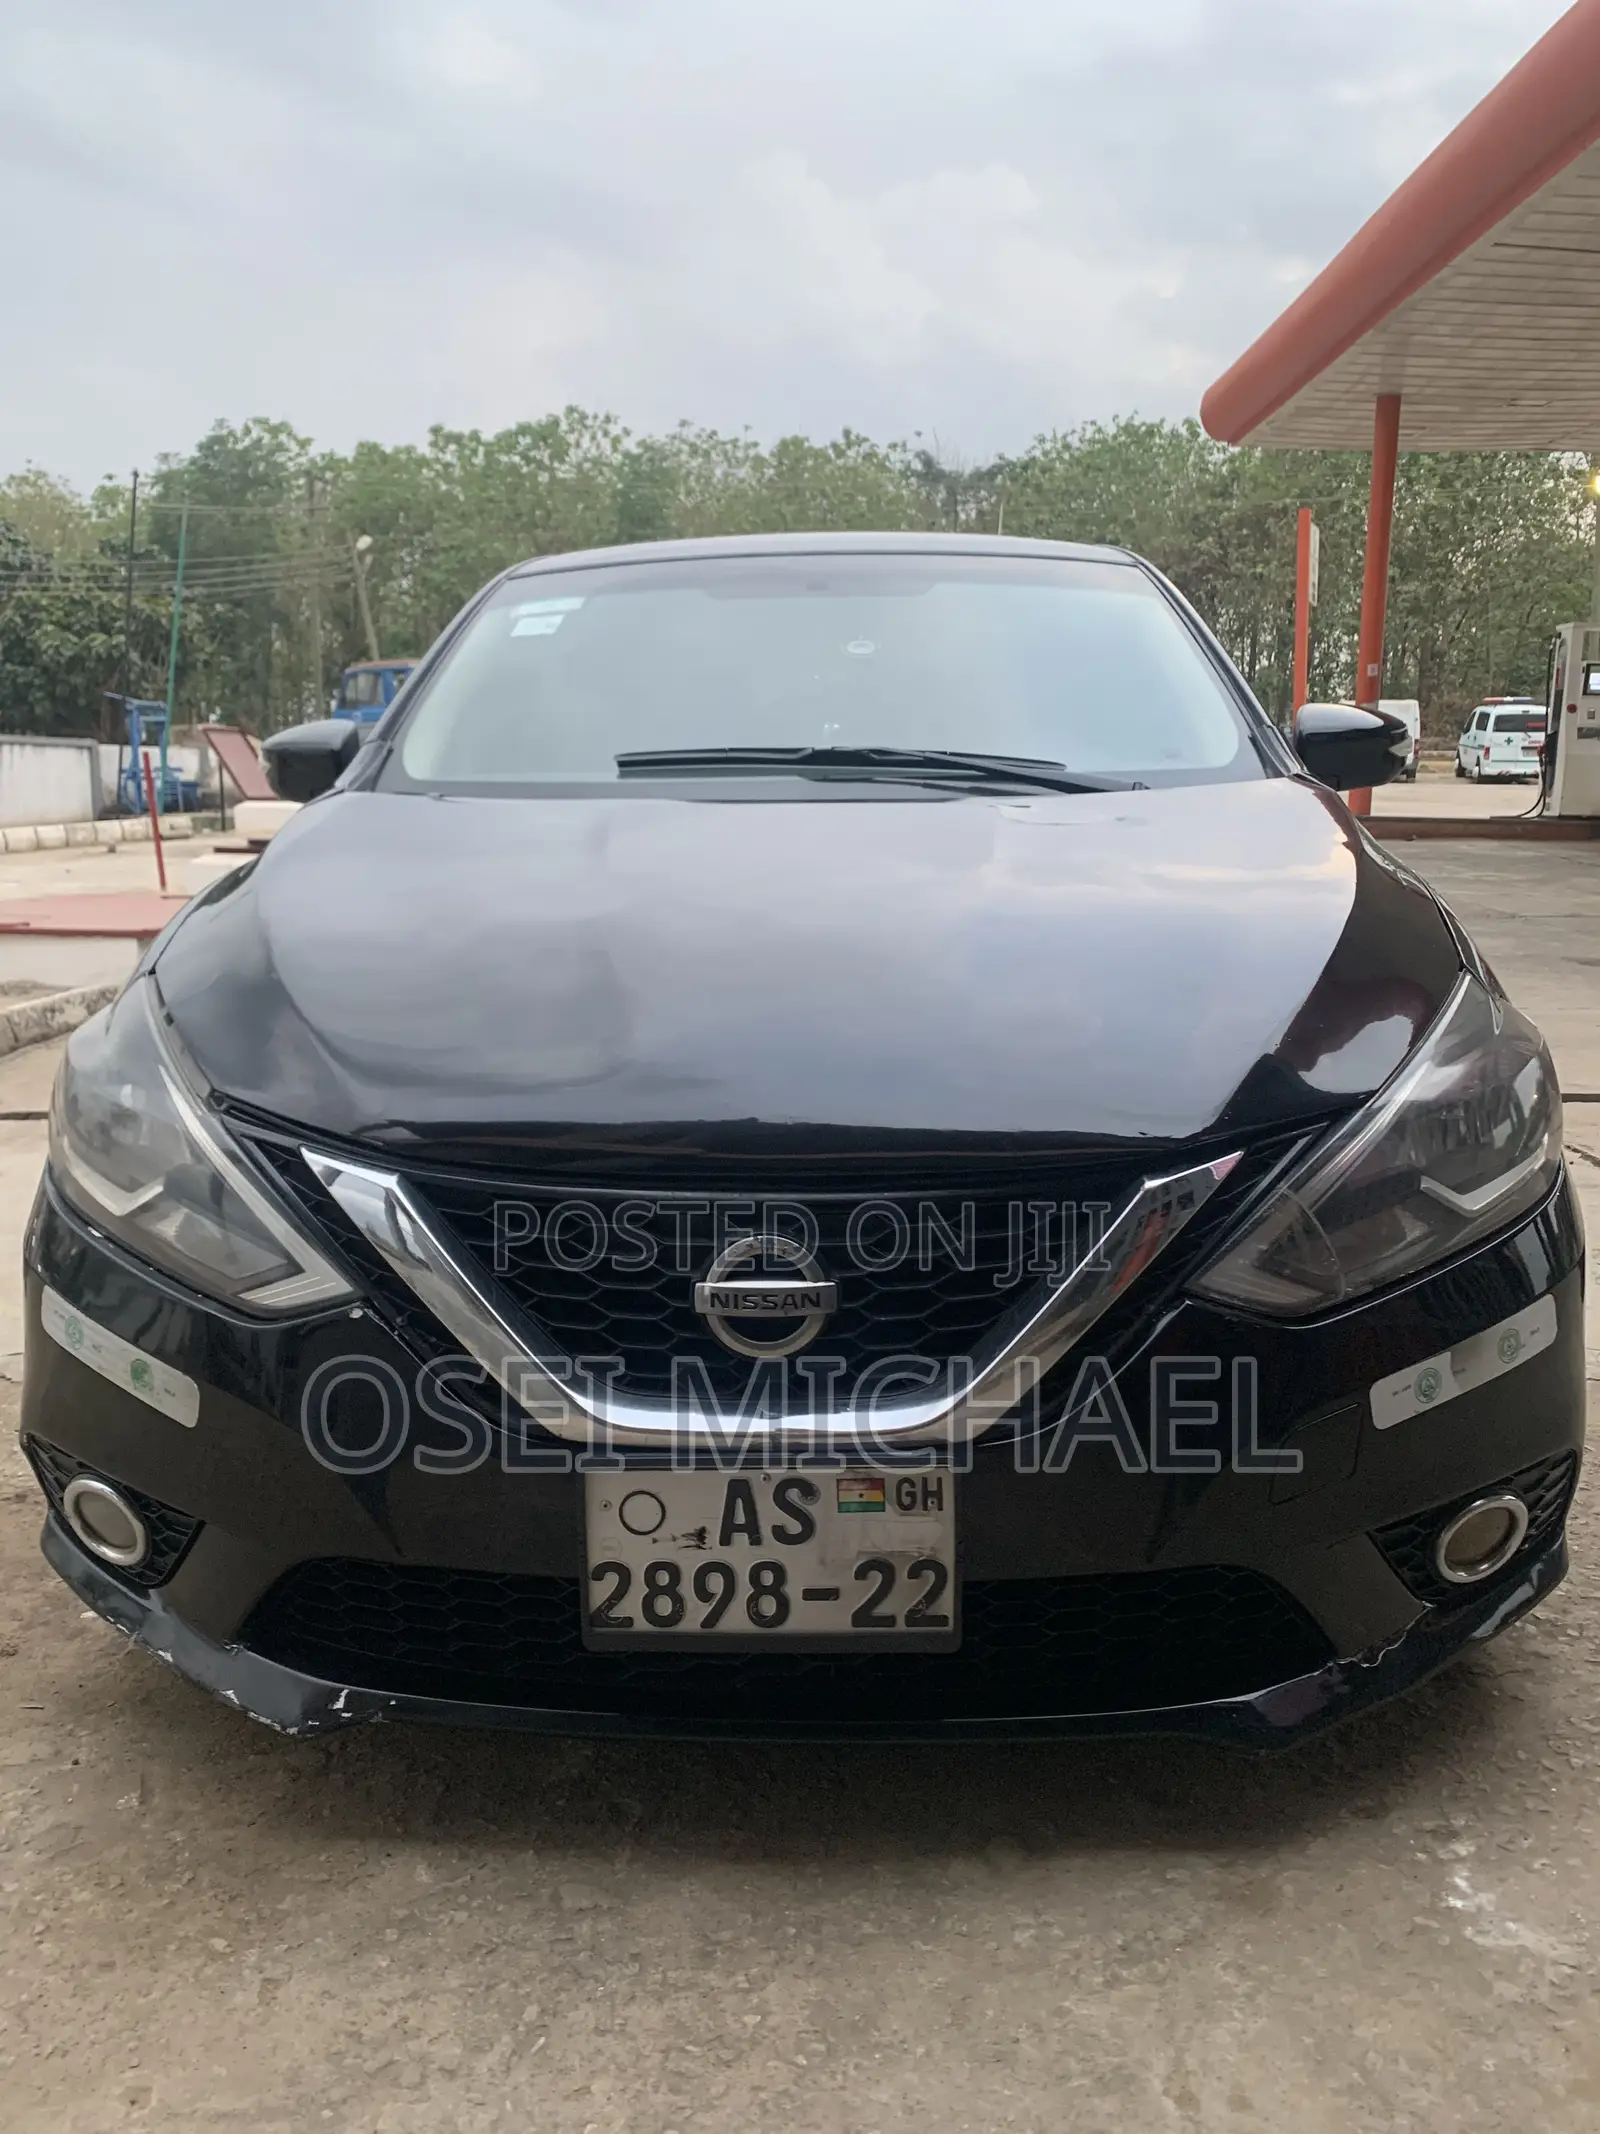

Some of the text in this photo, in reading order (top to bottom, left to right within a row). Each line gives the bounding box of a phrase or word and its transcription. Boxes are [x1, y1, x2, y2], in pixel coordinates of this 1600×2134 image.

[709, 1291, 822, 1311] NISSAN
[718, 1476, 819, 1547] AS
[894, 1476, 944, 1512] GH
[589, 1559, 950, 1629] 2898-22
